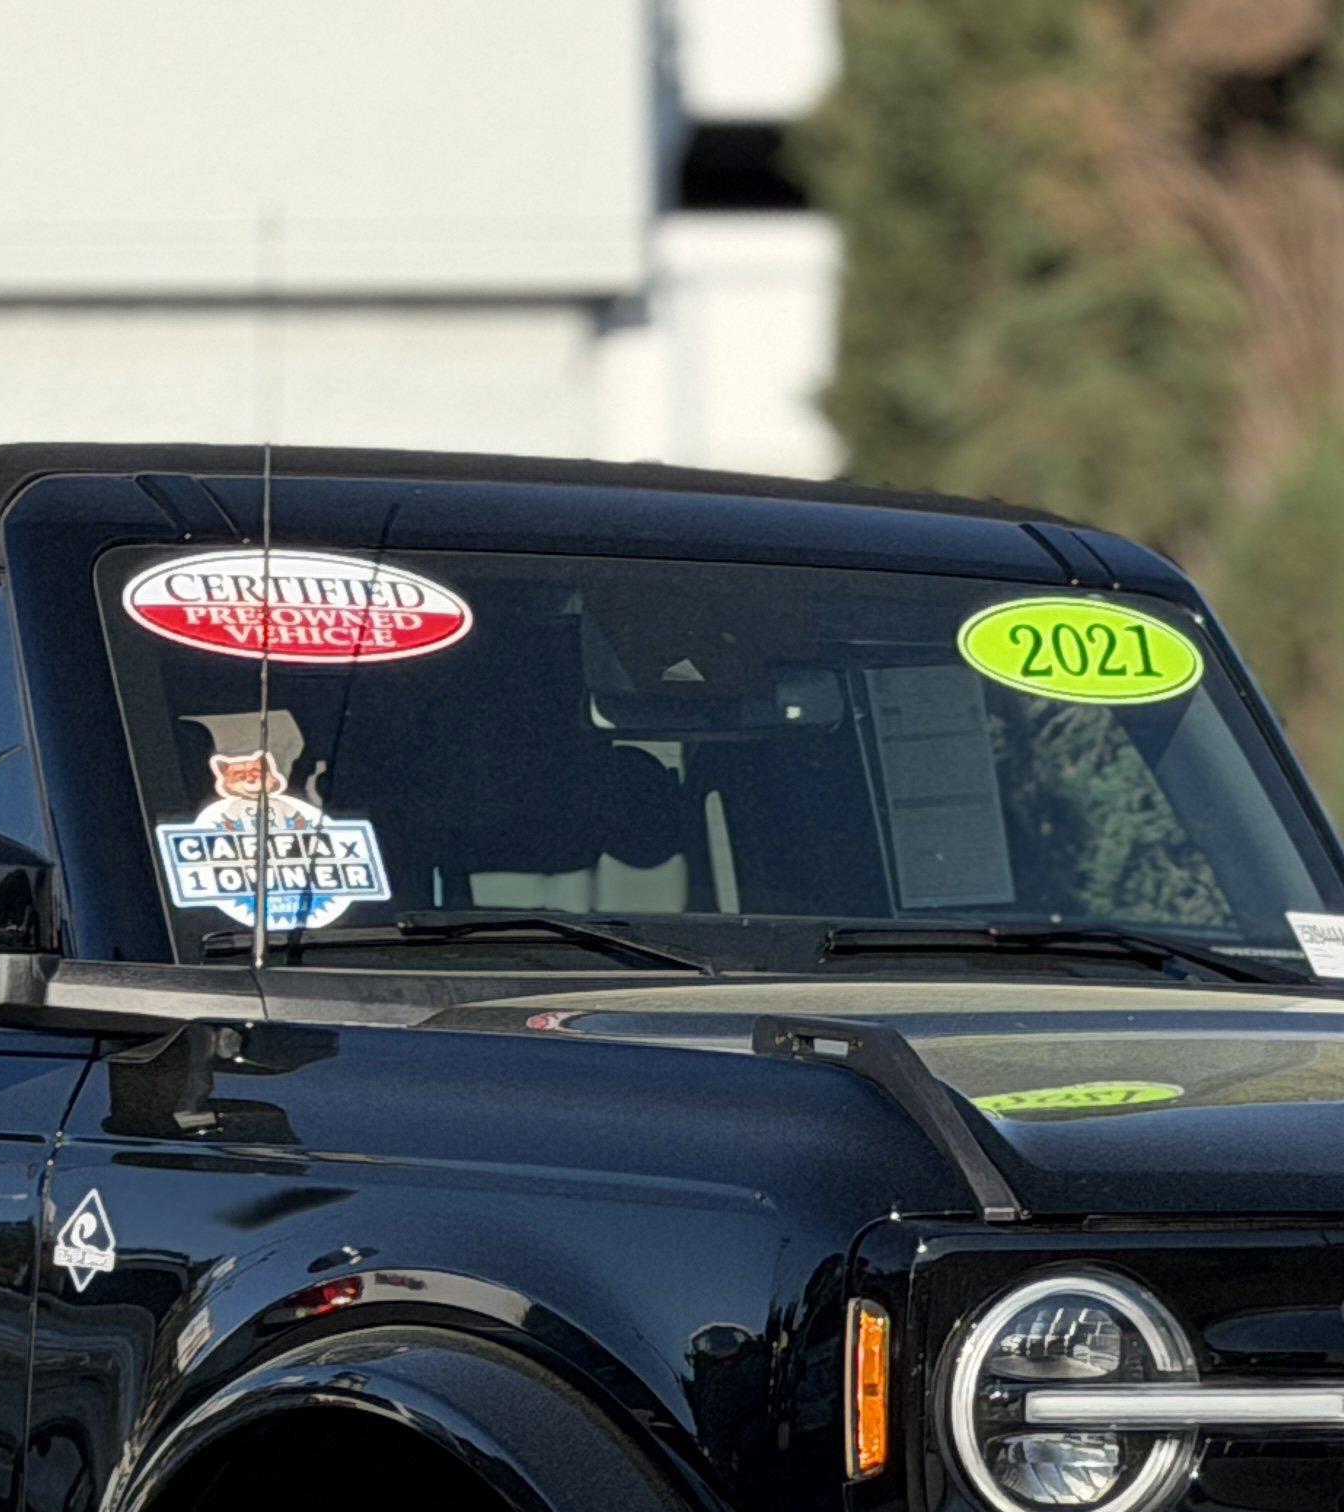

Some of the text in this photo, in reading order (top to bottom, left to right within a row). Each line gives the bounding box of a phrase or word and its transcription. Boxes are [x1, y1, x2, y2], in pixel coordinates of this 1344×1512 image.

[164, 572, 425, 609] CERTIFIED
[223, 624, 397, 648] VEHICLE
[1009, 623, 1164, 677] 2021
[178, 836, 361, 862] CARFAX
[187, 870, 208, 891] 1
